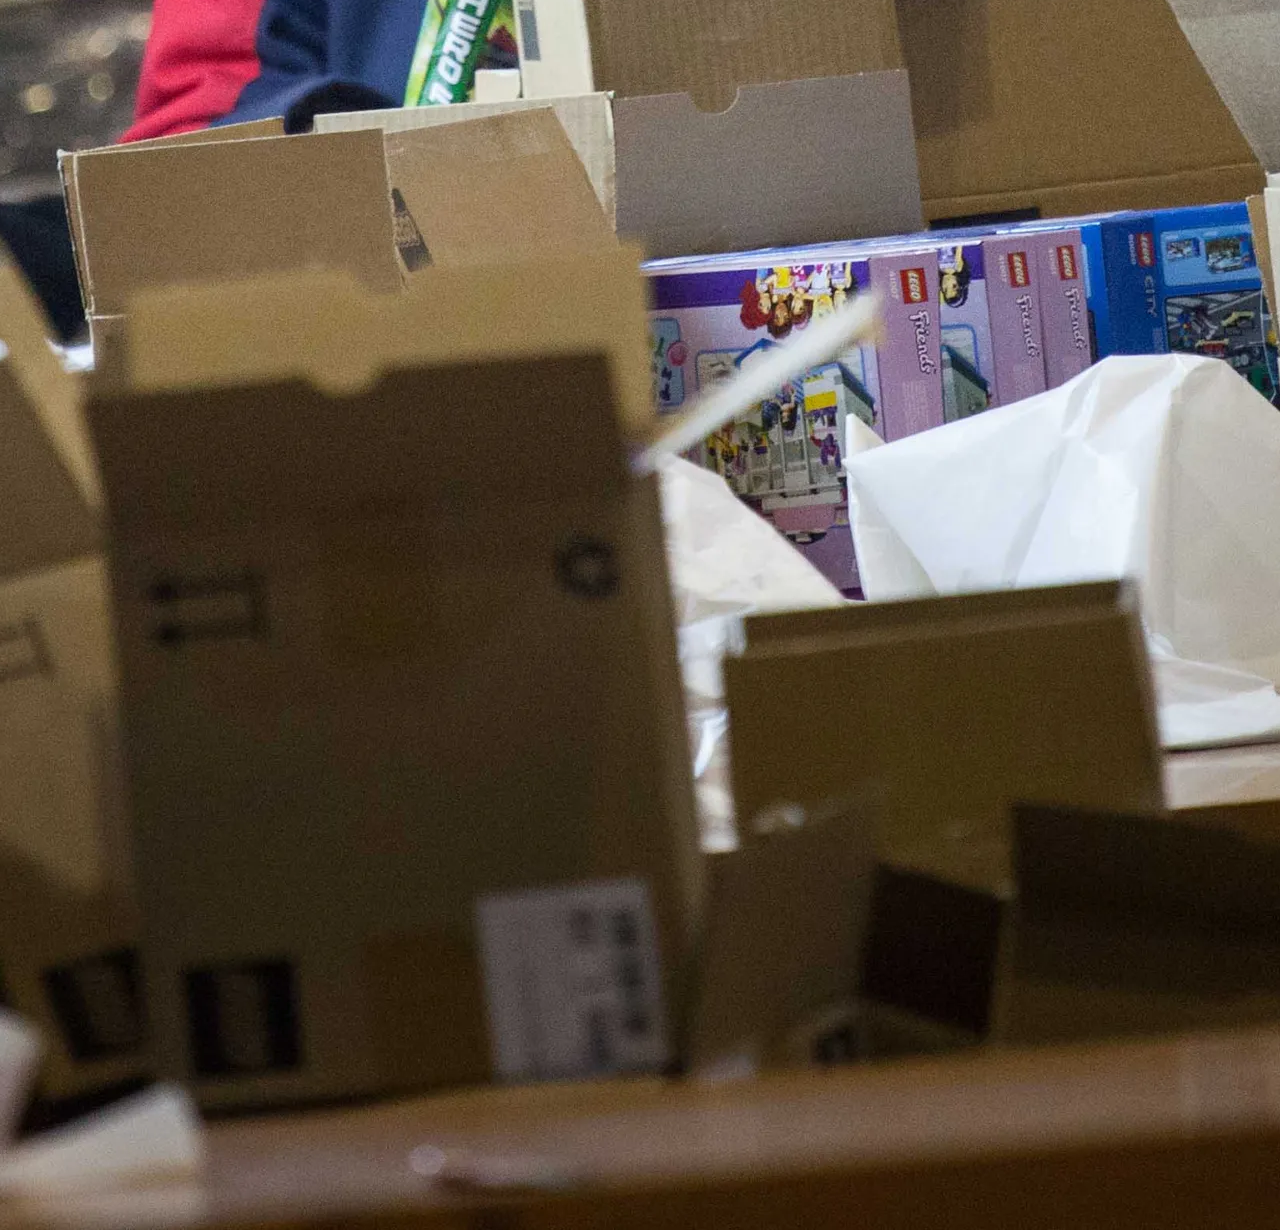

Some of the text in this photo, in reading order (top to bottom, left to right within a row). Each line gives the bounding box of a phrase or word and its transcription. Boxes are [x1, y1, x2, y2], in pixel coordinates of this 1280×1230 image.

[906, 271, 923, 303] LEGO
[1013, 255, 1026, 286] LEGO
[1144, 275, 1157, 318] CITY
[910, 310, 935, 374] Friends
[1016, 295, 1040, 357] Friends
[1065, 287, 1087, 349] Friends
